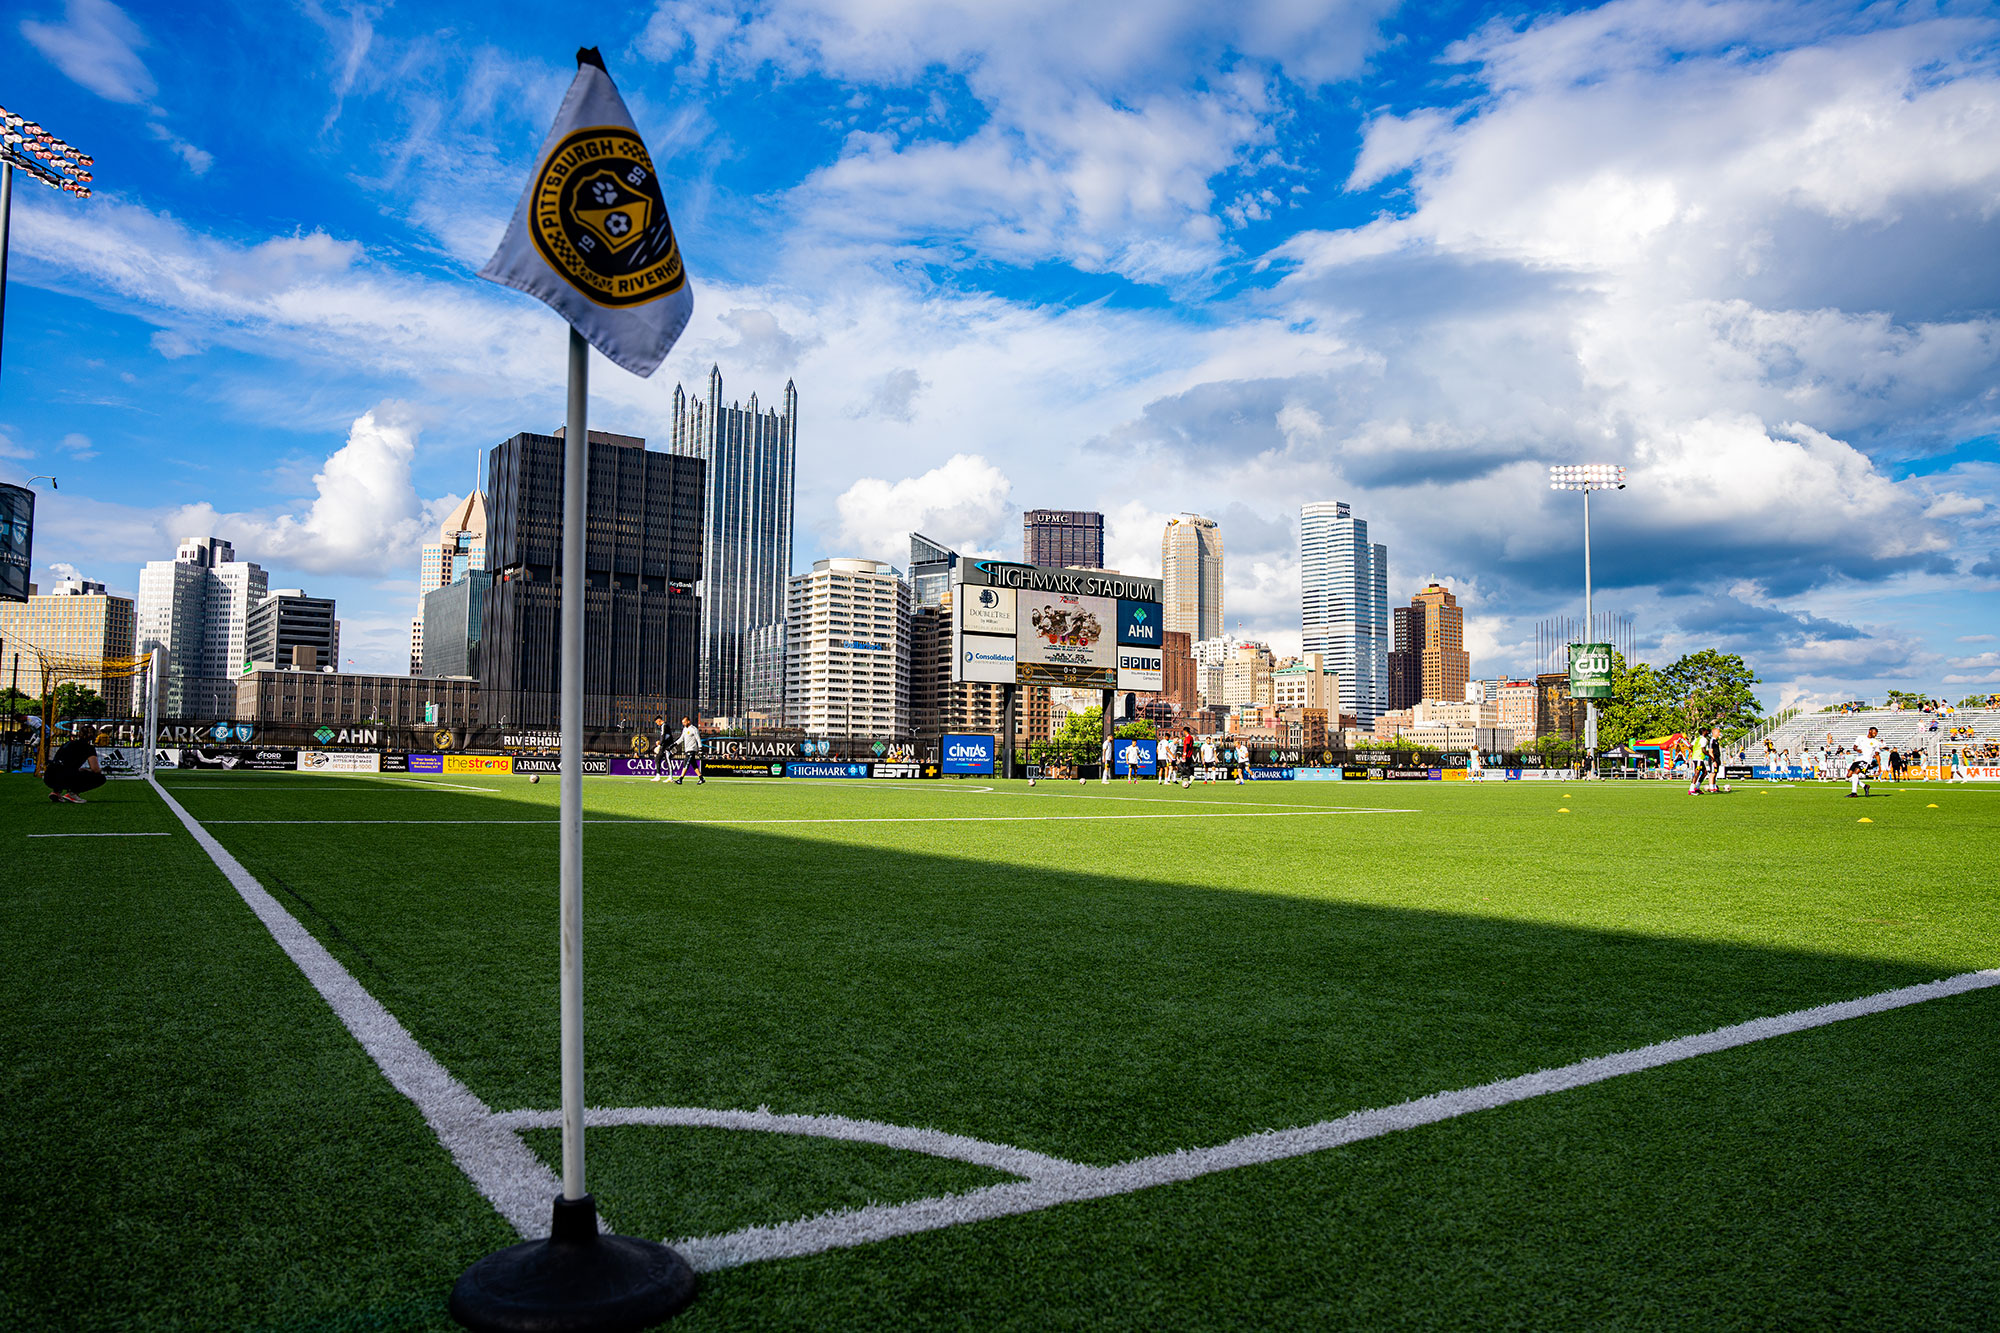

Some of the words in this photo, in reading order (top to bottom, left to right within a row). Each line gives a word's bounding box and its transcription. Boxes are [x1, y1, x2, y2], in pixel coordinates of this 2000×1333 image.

[627, 165, 647, 186] 99
[540, 139, 614, 229] PITTSBURGH
[578, 234, 596, 253] 19
[1037, 514, 1068, 523] UPMC
[987, 563, 1081, 595] HIGHMARK
[1086, 577, 1153, 601] STADIUM
[1128, 624, 1153, 639] AHN
[975, 652, 1014, 662] Consolidated
[1121, 657, 1160, 669] EPIC
[1575, 659, 1609, 673] CW
[337, 729, 378, 745] AHN
[504, 736, 562, 746] RIVERHOU
[708, 740, 795, 756] HIGHMARK
[948, 742, 987, 757] CINTAS
[1280, 751, 1298, 762] AHN
[516, 760, 557, 770] ARMINA
[626, 758, 684, 770] CAROW
[793, 765, 847, 776] HIGHMARK
[873, 764, 921, 778] ESPN
